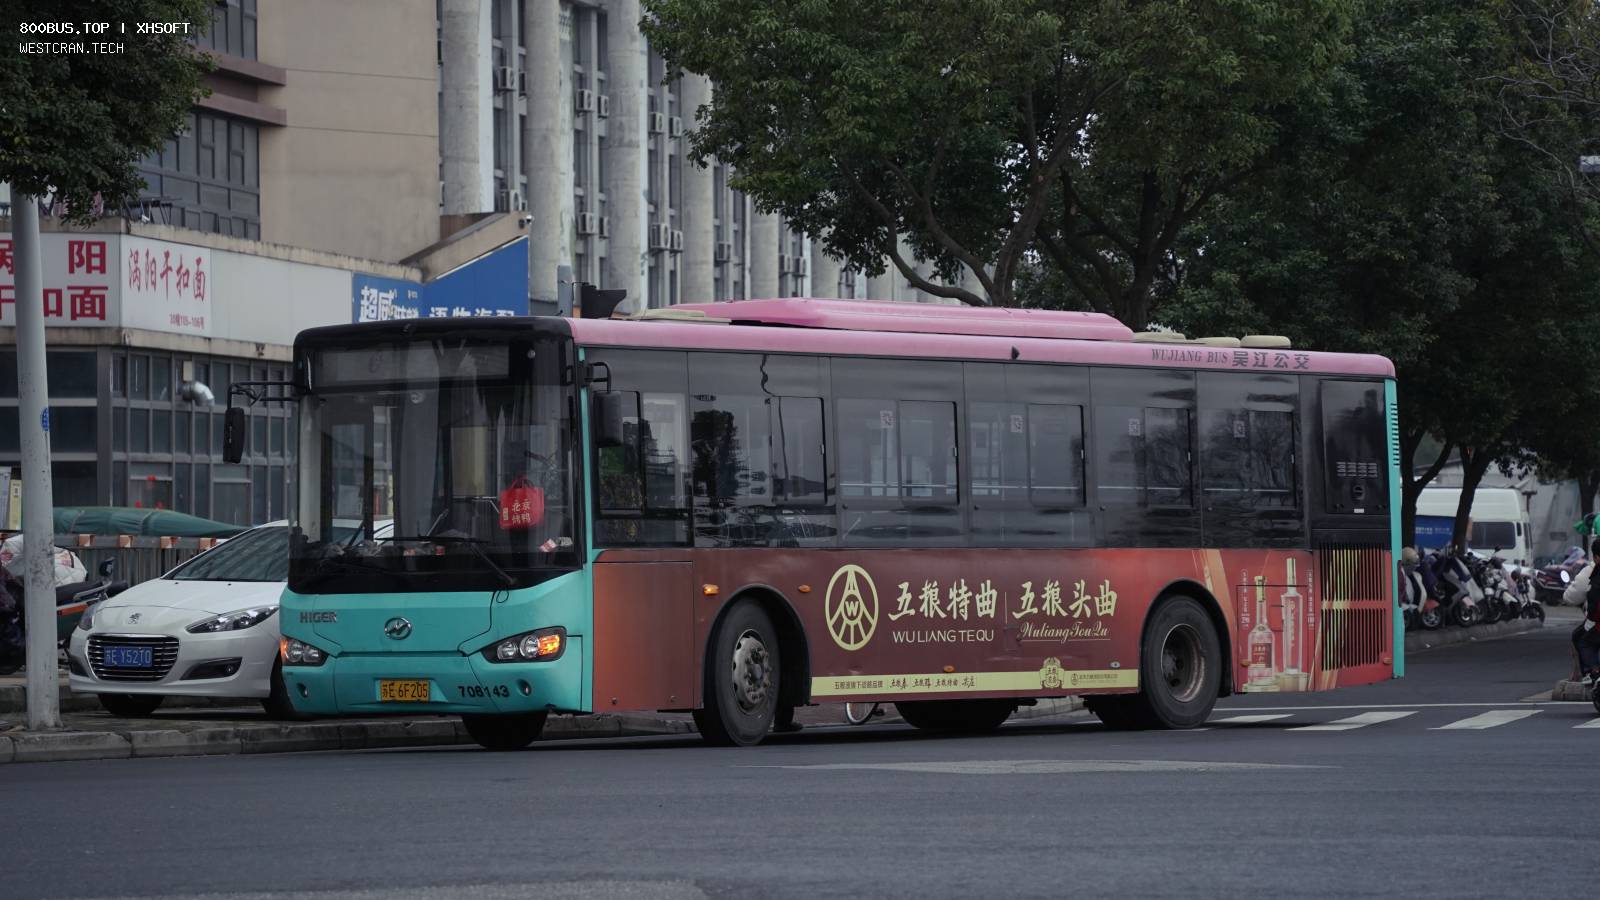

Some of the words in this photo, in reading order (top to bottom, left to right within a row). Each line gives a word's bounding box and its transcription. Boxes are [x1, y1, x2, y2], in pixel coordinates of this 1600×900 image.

[1151, 348, 1202, 362] WUJIANG
[1207, 351, 1228, 364] BUS
[1232, 350, 1310, 370] 吴江公交
[887, 578, 998, 621] 五粮特曲
[1012, 579, 1118, 619] 五粮头曲
[299, 611, 337, 623] HIGER
